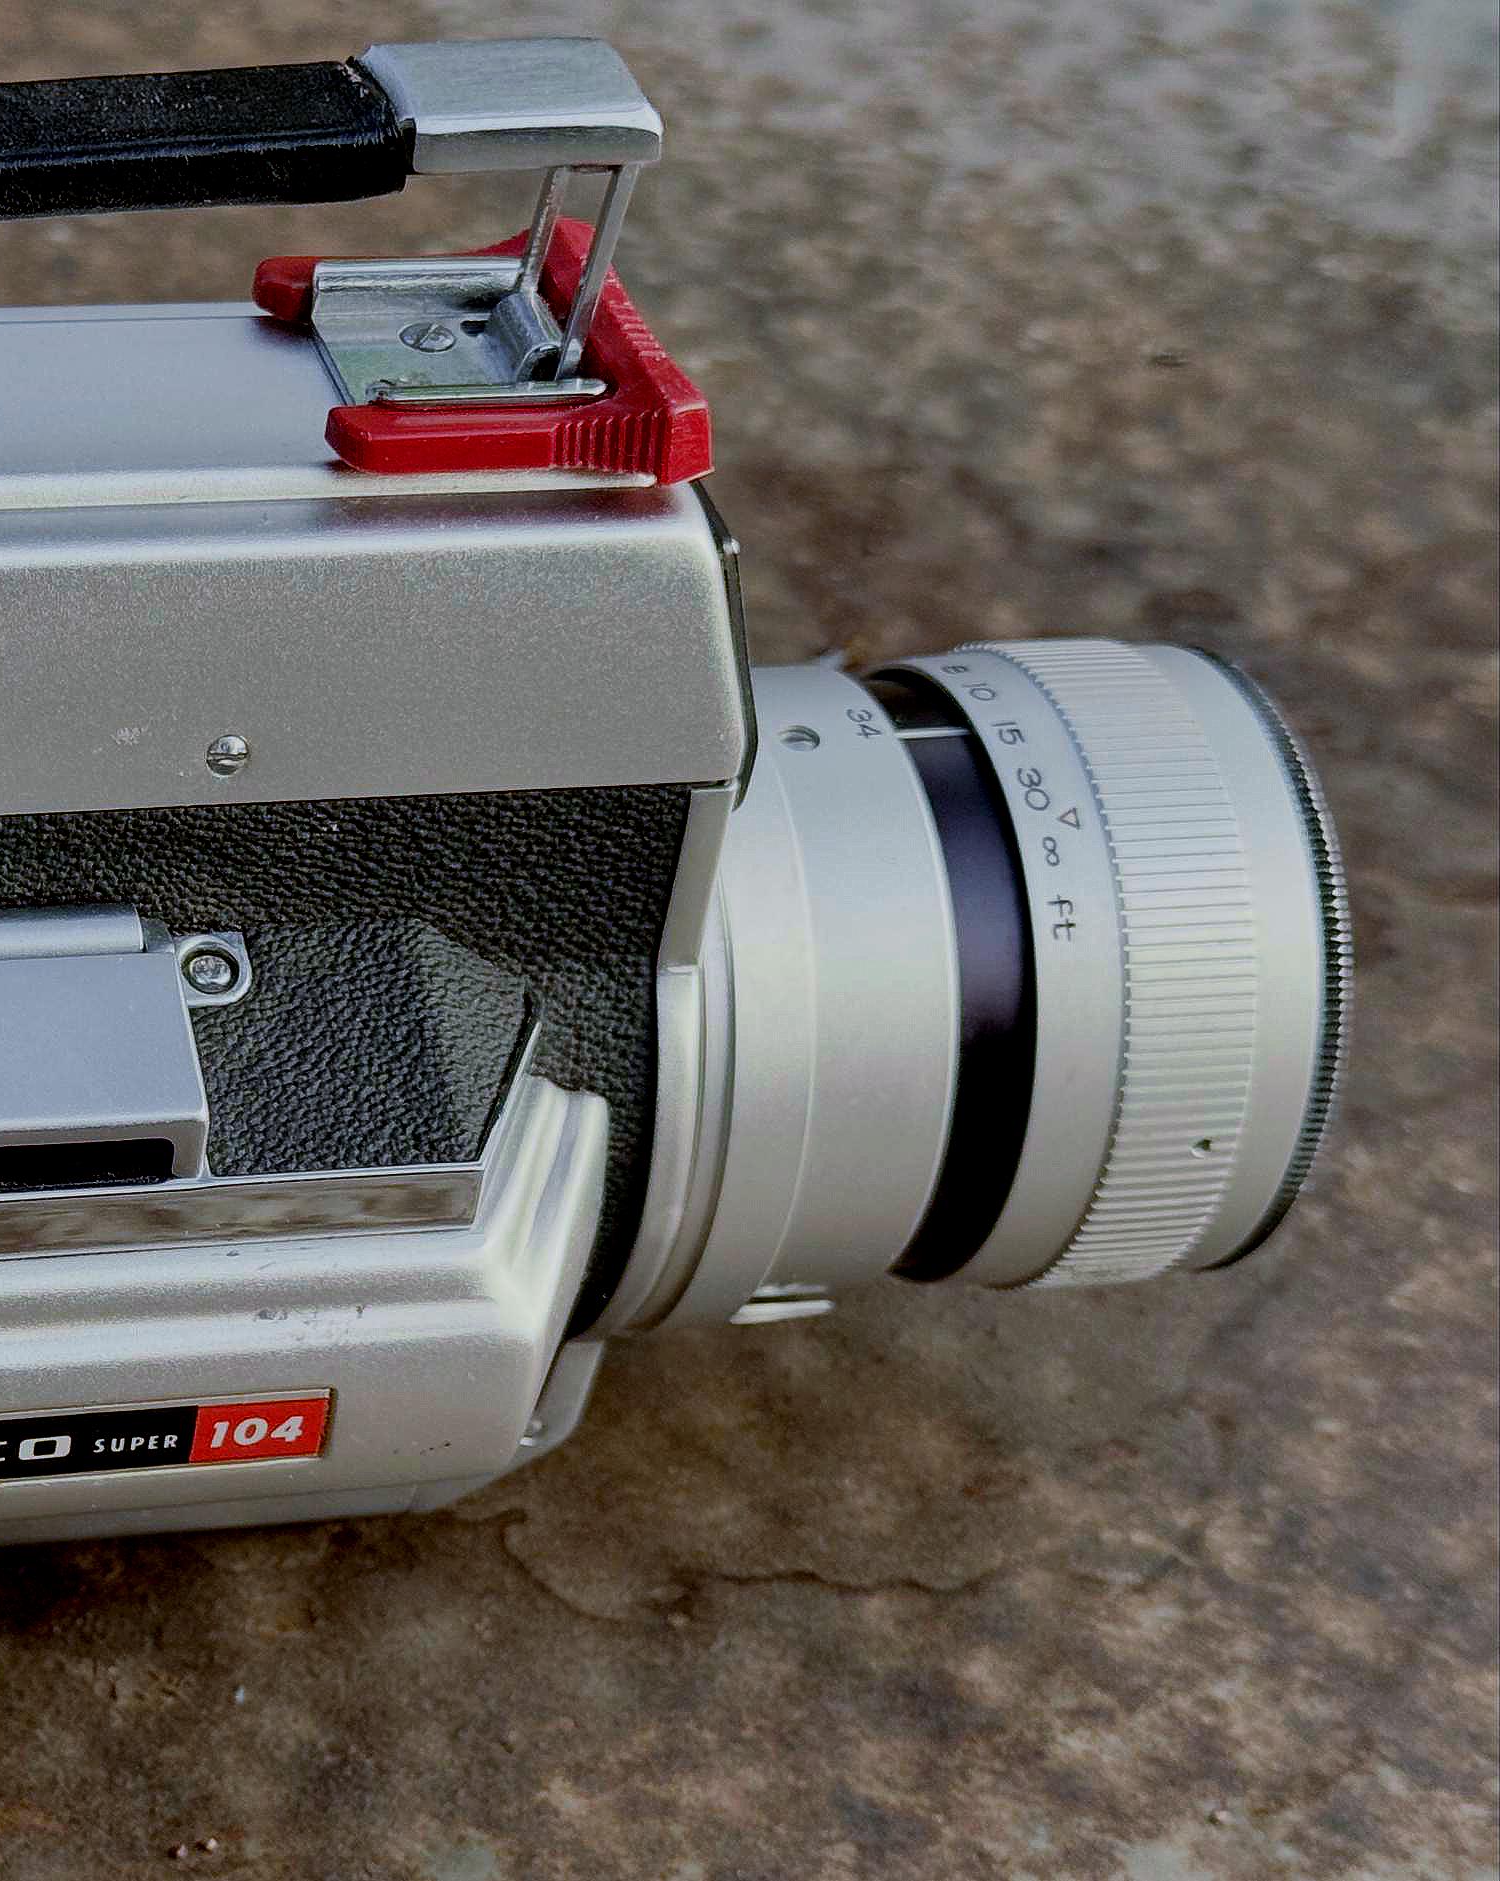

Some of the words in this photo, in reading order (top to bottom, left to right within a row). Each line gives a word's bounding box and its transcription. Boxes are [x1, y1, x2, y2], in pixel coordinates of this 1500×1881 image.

[845, 708, 882, 739] 34
[961, 681, 996, 701] 10
[991, 721, 1026, 746] 15
[1016, 767, 1051, 811] 30
[1047, 894, 1077, 942] ft
[92, 1433, 179, 1454] SUPER
[209, 1415, 304, 1449] 104
